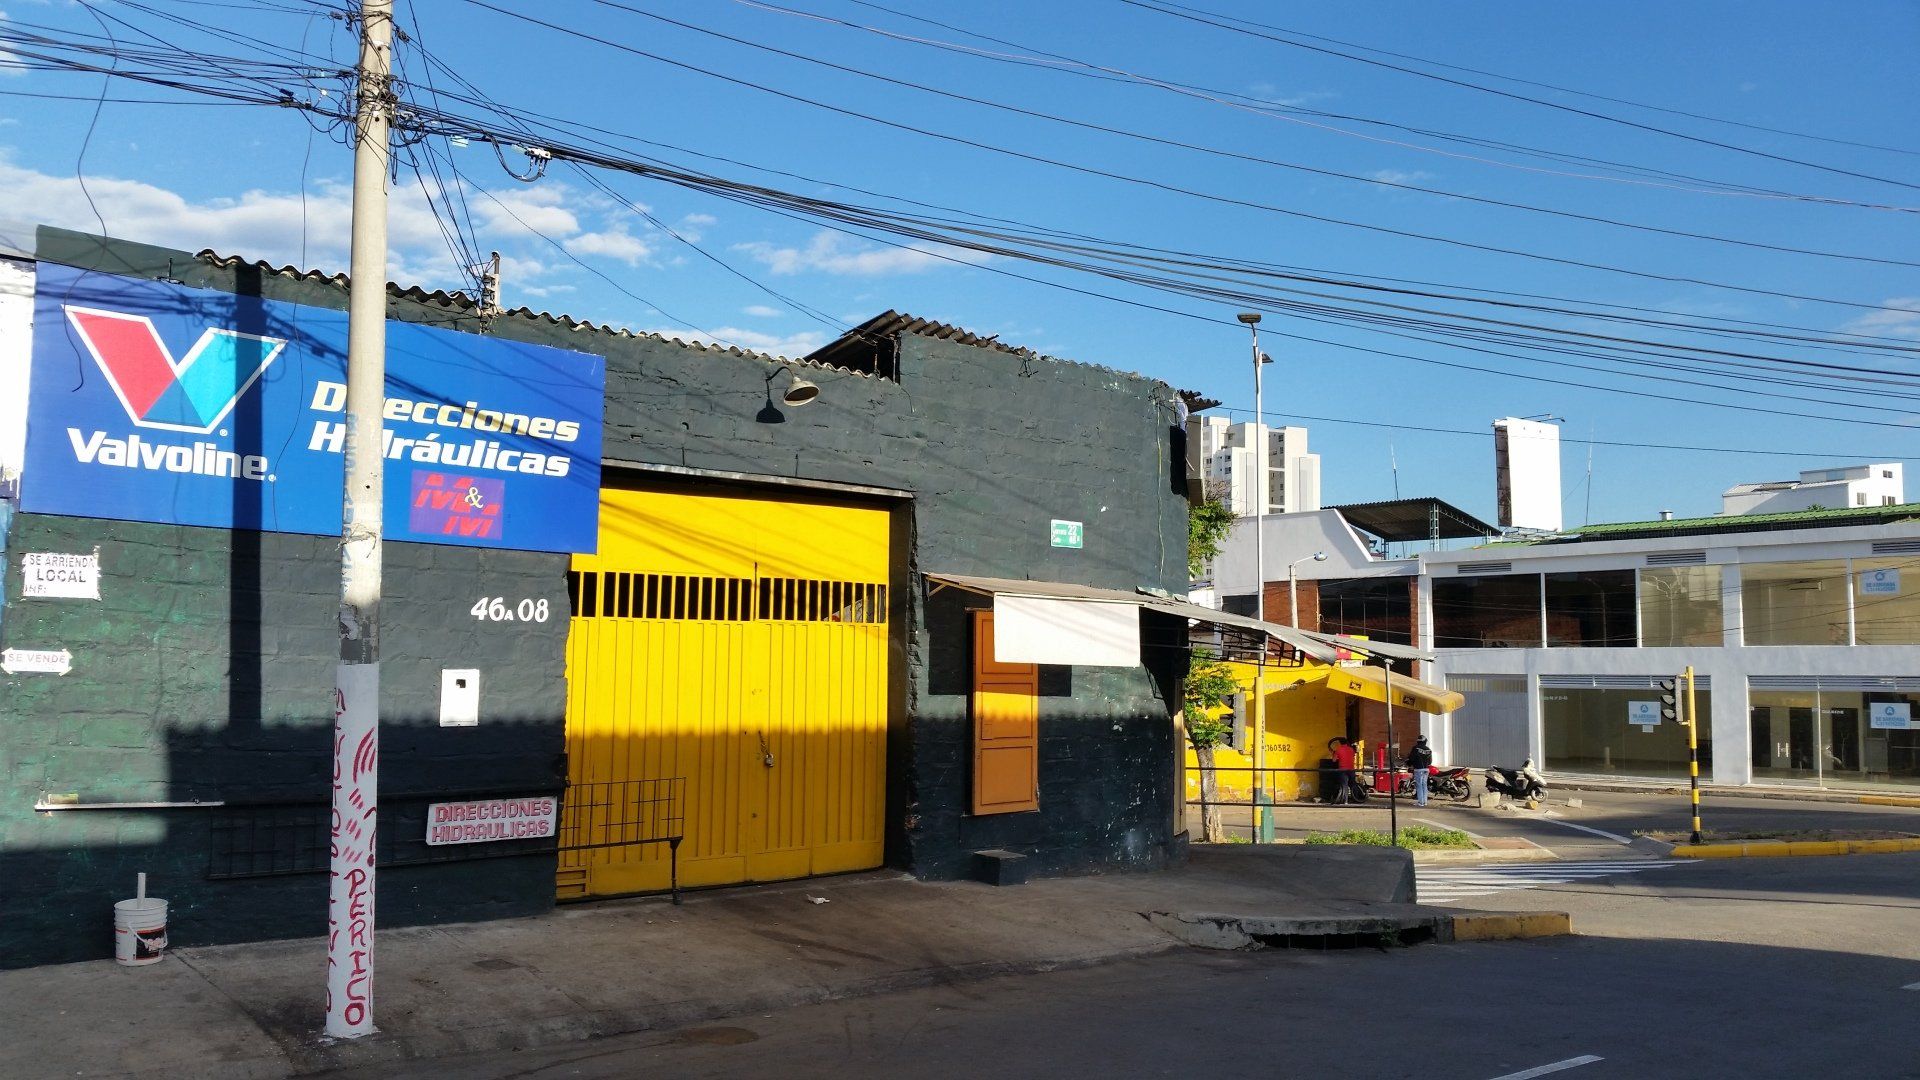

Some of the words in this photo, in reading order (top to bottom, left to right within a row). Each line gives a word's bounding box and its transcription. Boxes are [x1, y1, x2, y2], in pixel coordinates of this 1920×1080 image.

[309, 380, 580, 442] Decciones
[67, 427, 268, 481] Valvoline
[307, 420, 571, 477] Hráulicas
[29, 554, 42, 566] SE
[36, 568, 87, 583] LOCAL
[517, 598, 549, 623] 08
[8, 653, 23, 662] SE
[27, 653, 66, 664] VENDE
[435, 800, 553, 823] DIRECCIONES
[431, 819, 550, 843] HIDRAULICAS
[344, 868, 368, 1026] PERICO
